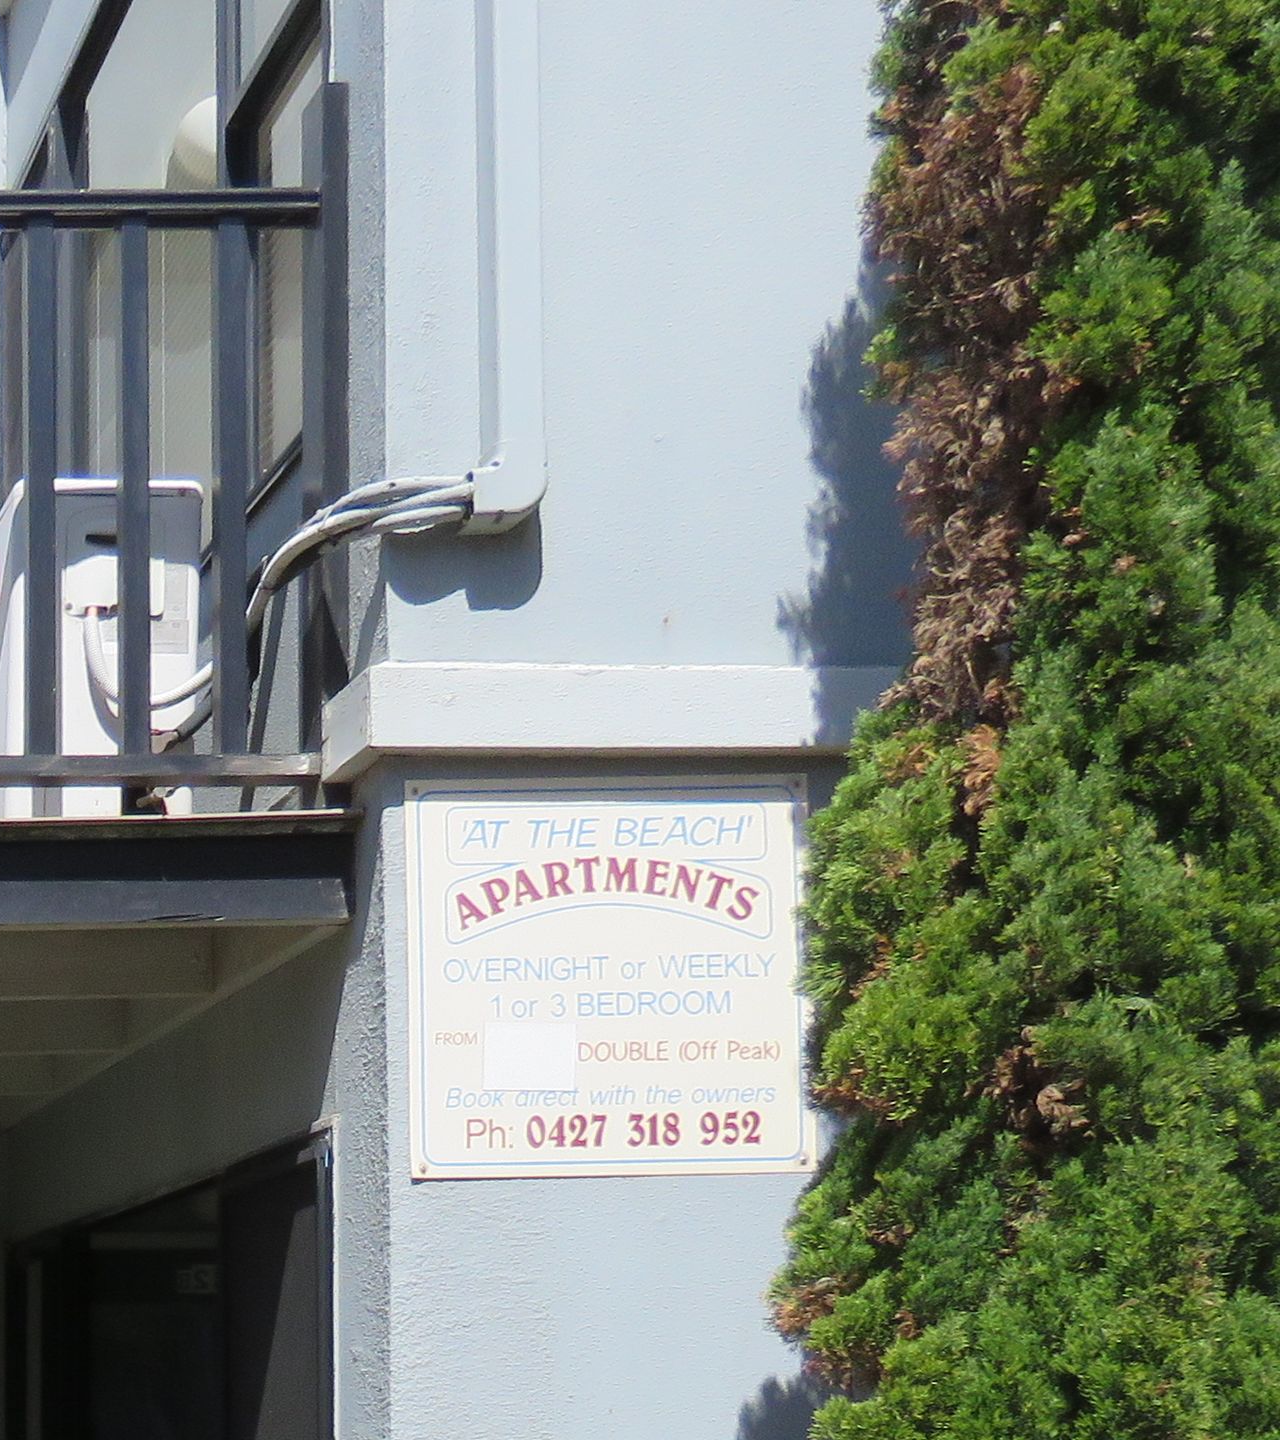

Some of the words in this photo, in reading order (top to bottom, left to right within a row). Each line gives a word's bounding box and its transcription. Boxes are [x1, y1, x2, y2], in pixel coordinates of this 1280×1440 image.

[527, 818, 600, 848] THE
[455, 856, 760, 930] APARTMENTS
[443, 956, 609, 983] OVERNIGHT
[620, 960, 647, 980] or
[658, 953, 776, 978] WEEKLY
[490, 995, 502, 1018] 1
[511, 998, 538, 1018] or
[550, 993, 566, 1017] 3
[576, 990, 732, 1017] BEDROOM
[435, 1032, 478, 1046] FROM
[578, 1041, 669, 1062] DOUBLE
[678, 1040, 719, 1062] (Off
[727, 1040, 781, 1062] Peak)
[445, 1088, 505, 1109] Book
[514, 1089, 579, 1108] direct
[590, 1086, 633, 1106] with
[646, 1086, 682, 1105] the
[691, 1087, 776, 1105] owners
[465, 1118, 514, 1149] Ph:
[526, 1114, 608, 1148] 0427
[627, 1112, 681, 1147] 318
[699, 1111, 761, 1146] 952
